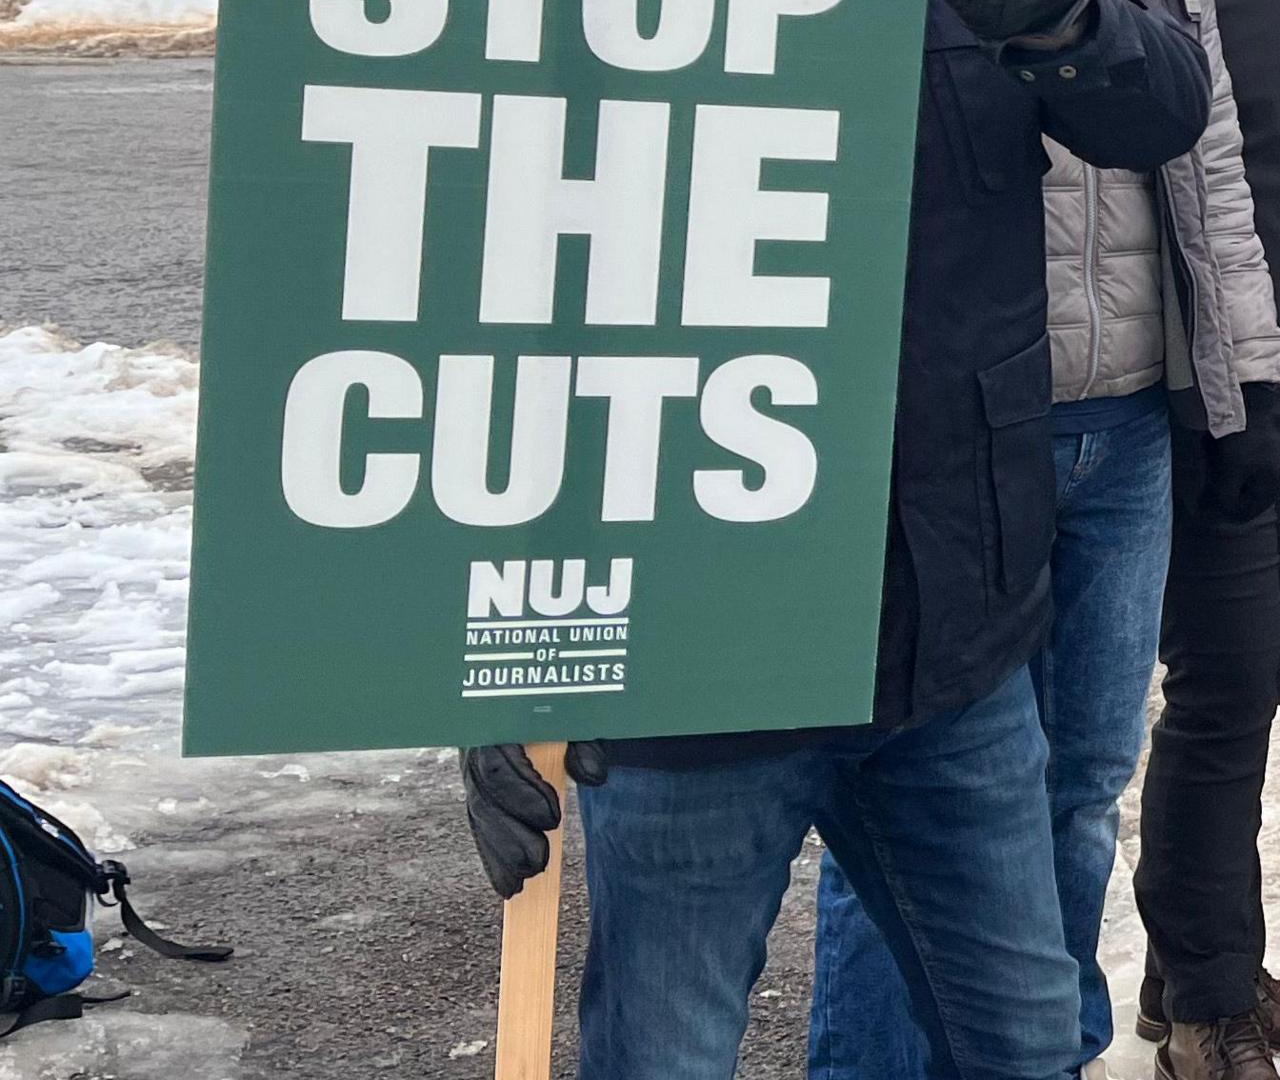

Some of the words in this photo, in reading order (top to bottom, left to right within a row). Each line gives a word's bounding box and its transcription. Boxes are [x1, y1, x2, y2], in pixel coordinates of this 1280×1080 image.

[301, 85, 840, 327] THE
[281, 349, 819, 528] CUTS
[467, 558, 633, 618] NUJ
[466, 628, 560, 645] NATIONAL
[569, 626, 627, 642] UNION
[536, 648, 556, 661] OF
[462, 663, 625, 687] JOURNALISTS
